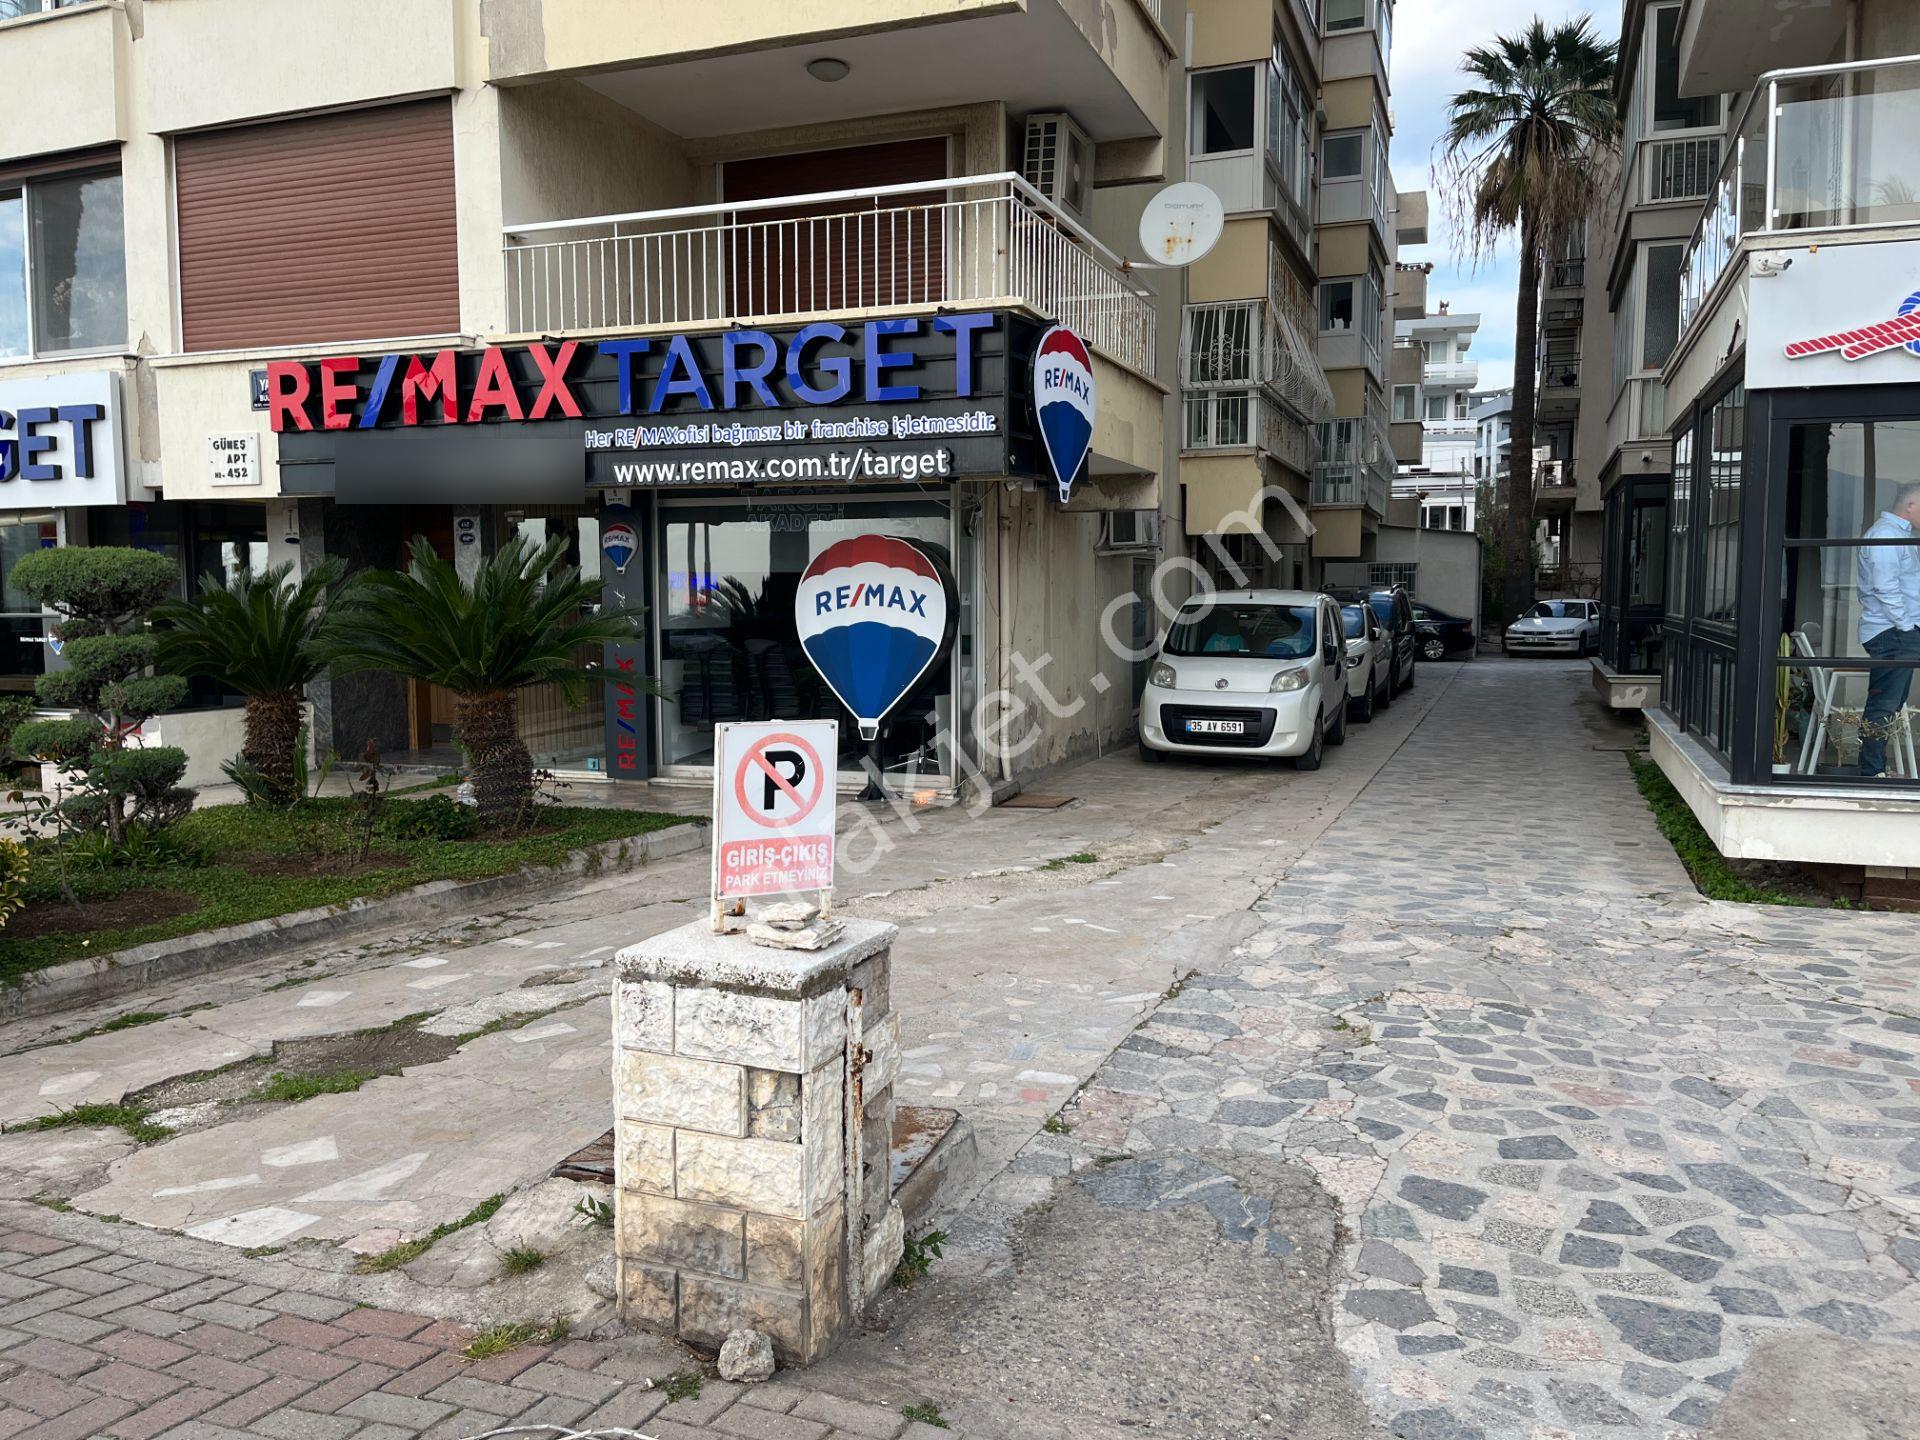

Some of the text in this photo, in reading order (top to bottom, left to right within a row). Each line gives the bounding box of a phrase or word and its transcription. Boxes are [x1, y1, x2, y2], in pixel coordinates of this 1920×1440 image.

[267, 313, 994, 432] RE/MAX TARGET
[1044, 367, 1090, 404] RE/MAX
[585, 430, 612, 448] Her
[711, 422, 781, 446] bağımsız
[784, 420, 809, 440] bir
[811, 418, 889, 439] franchise
[892, 411, 997, 438] işletmesidir.
[213, 437, 246, 451] GÜNEŞ
[227, 454, 247, 464] APT
[614, 448, 947, 483] www.remax.com.tr/target
[227, 467, 248, 479] 452
[815, 583, 927, 618] RE/MAX
[1192, 721, 1242, 732] 35 AV 6591
[726, 843, 828, 868] GİRİŞ-ÇIKIŞ
[725, 873, 760, 888] PARK
